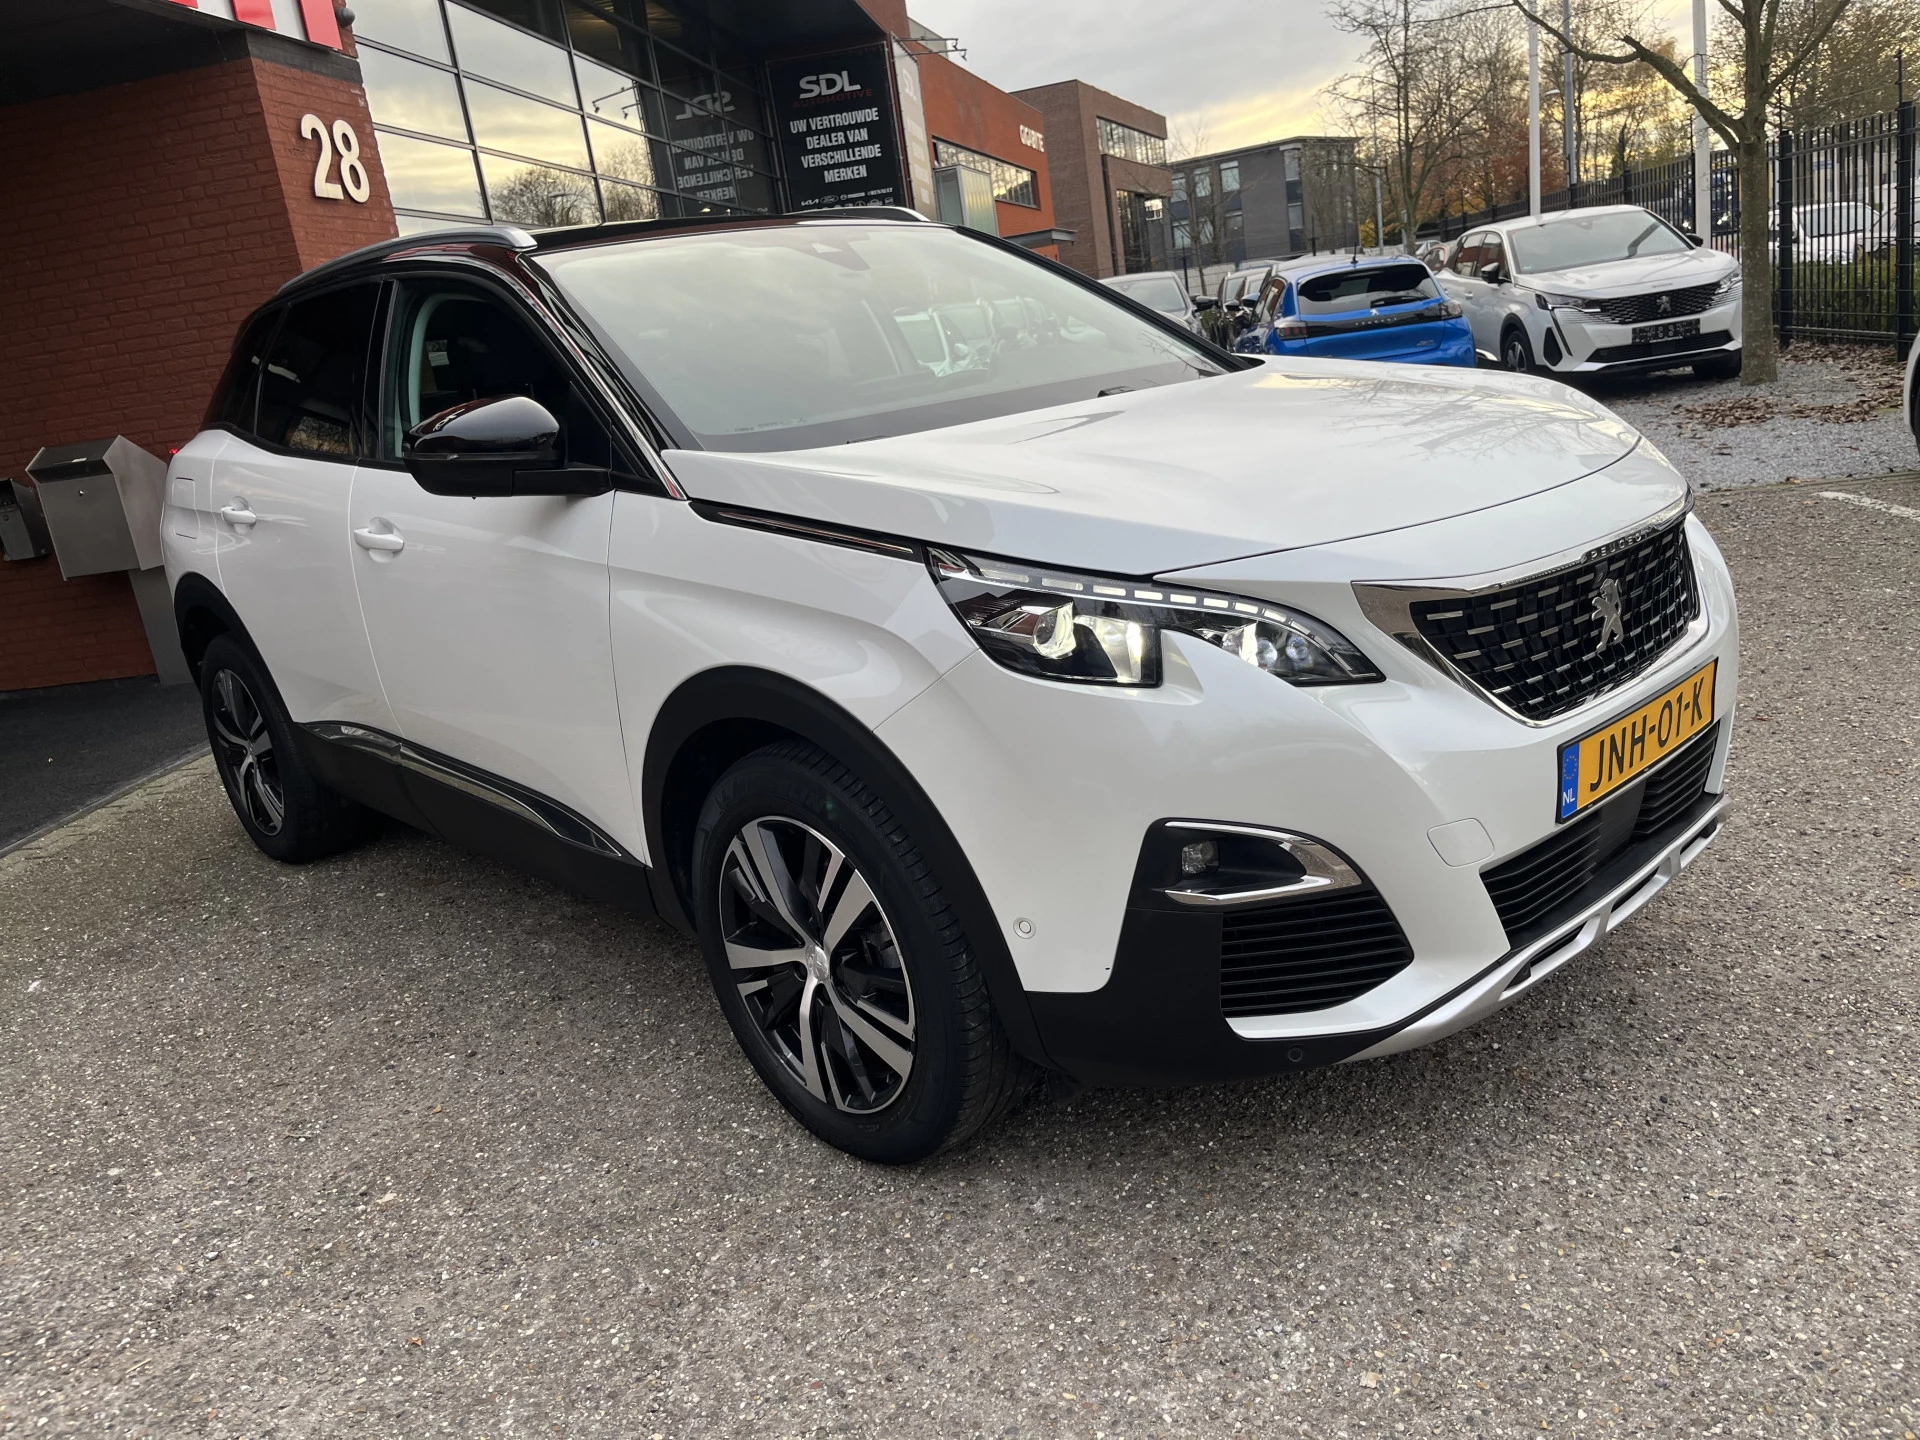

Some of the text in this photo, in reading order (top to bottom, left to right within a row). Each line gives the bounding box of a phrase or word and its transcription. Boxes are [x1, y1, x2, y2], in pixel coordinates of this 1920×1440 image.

[798, 70, 861, 99] SDL
[792, 88, 873, 108] AUTOMOTIVE
[789, 107, 879, 134] UW VERTROUWDE
[805, 127, 869, 150] DEALER VAN
[300, 113, 370, 203] 28
[801, 144, 882, 169] VERSCHILLENDE
[823, 164, 868, 183] MERKEN
[1590, 526, 1652, 561] PEUGEOT
[1590, 676, 1704, 792] JNH-01-K
[1562, 788, 1575, 806] NL
